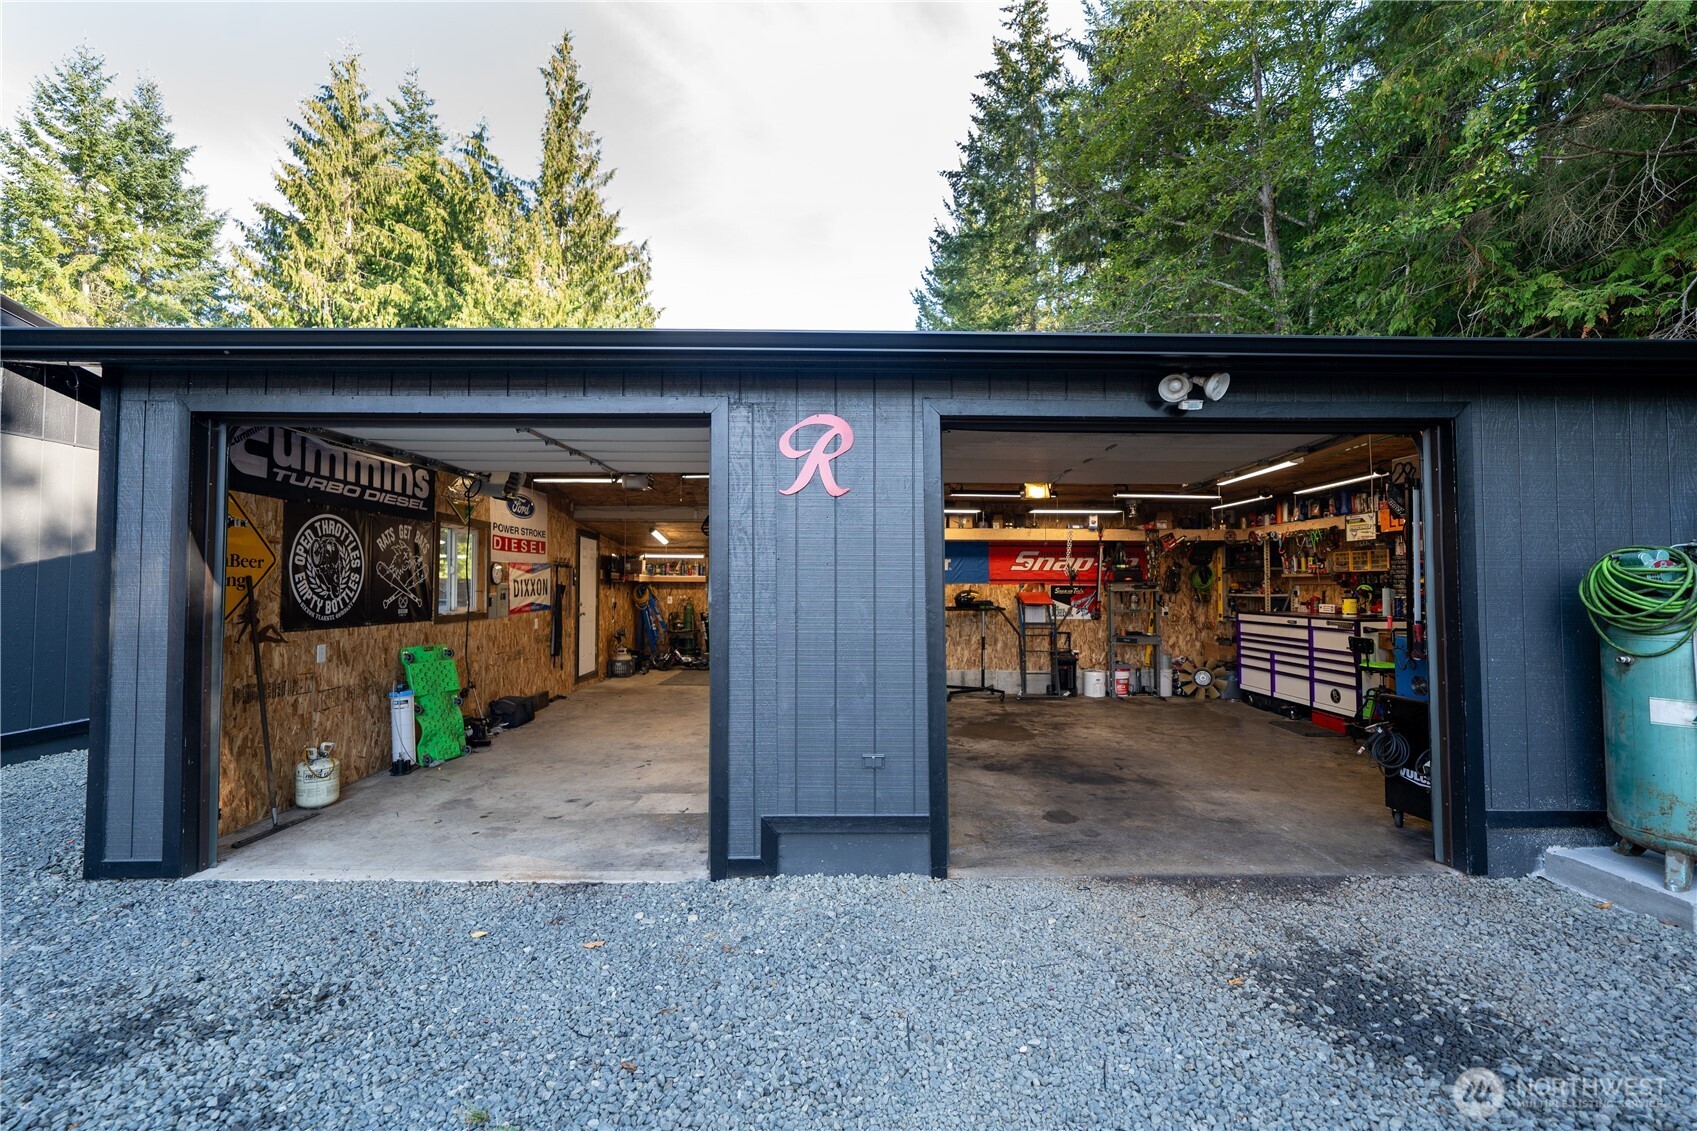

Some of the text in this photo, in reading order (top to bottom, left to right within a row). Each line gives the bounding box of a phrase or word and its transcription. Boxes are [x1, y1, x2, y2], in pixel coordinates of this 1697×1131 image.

[778, 413, 854, 497] R
[272, 468, 428, 511] TURBO DIESEL
[511, 499, 531, 515] Ford
[294, 520, 361, 568] OPEN THROTTLES
[376, 524, 430, 554] RATS GET BATS
[492, 522, 546, 539] POWER STROKE
[493, 538, 545, 553] DIESEL
[295, 572, 360, 614] EMPTY BOTTLES
[513, 578, 548, 598] DIXXON
